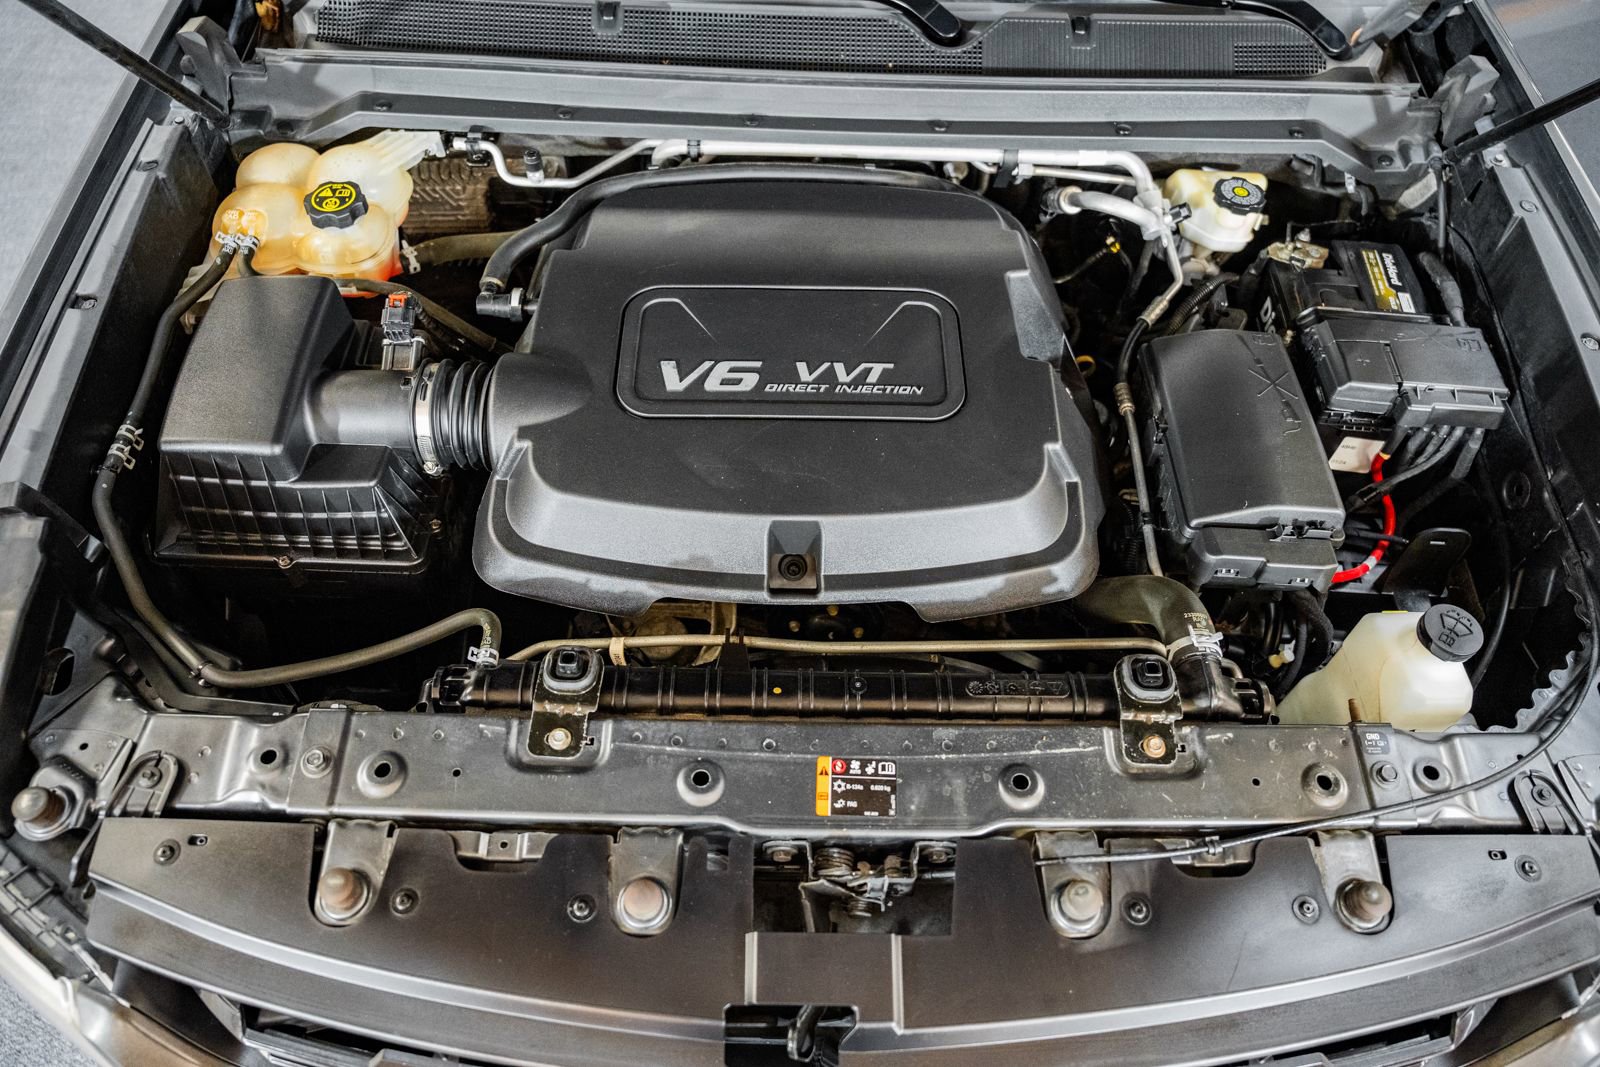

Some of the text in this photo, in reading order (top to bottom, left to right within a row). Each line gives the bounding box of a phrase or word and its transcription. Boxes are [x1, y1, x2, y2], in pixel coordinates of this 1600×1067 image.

[1382, 253, 1402, 286] DieHard
[660, 360, 895, 392] V6 VVT
[763, 383, 924, 395] DIRECT INJECTION
